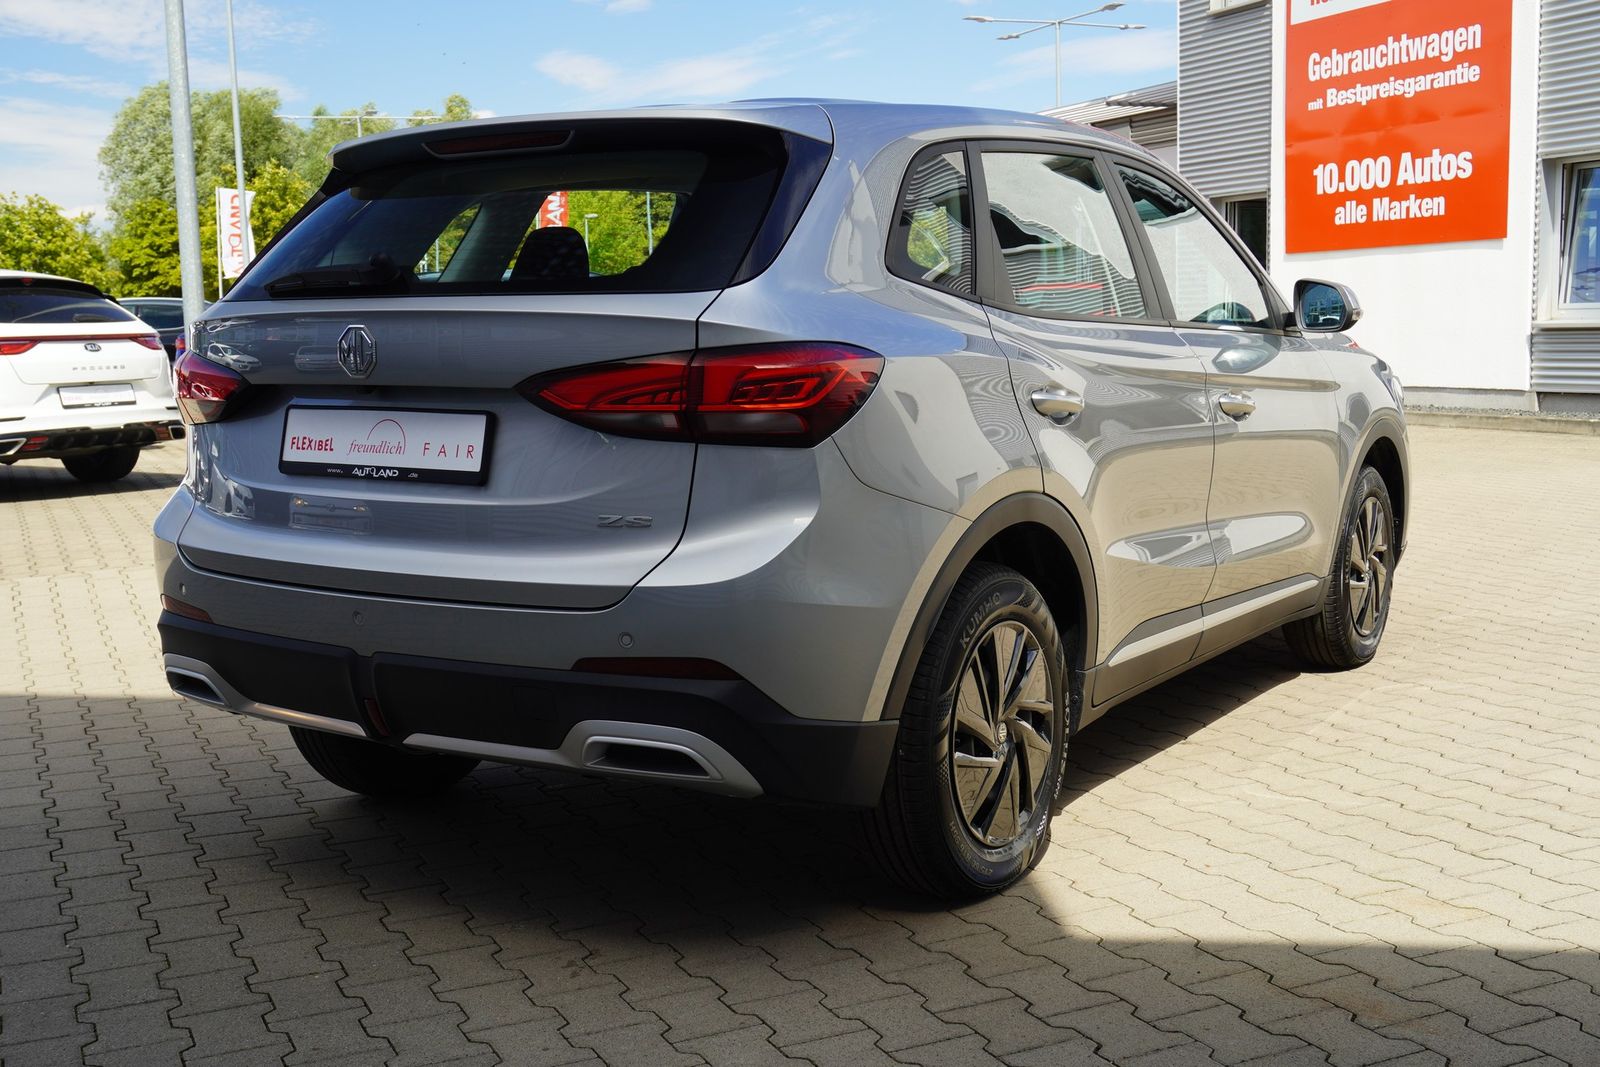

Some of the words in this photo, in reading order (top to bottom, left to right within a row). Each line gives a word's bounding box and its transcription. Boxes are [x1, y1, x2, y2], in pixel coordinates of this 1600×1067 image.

[1308, 23, 1482, 82] Gebrauchtwagen
[1308, 98, 1324, 111] mit
[1326, 62, 1480, 108] Bestpreisgarantie
[1313, 155, 1391, 195] 10.000
[1396, 149, 1473, 186] Autos
[1334, 200, 1367, 225] alle
[1372, 194, 1445, 222] Marken
[339, 328, 374, 376] MG
[290, 436, 334, 452] FLEXIBEL
[346, 440, 403, 456] freundlich
[423, 442, 474, 459] FAIR
[598, 514, 653, 528] ZS
[960, 592, 1001, 649] KUMHO
